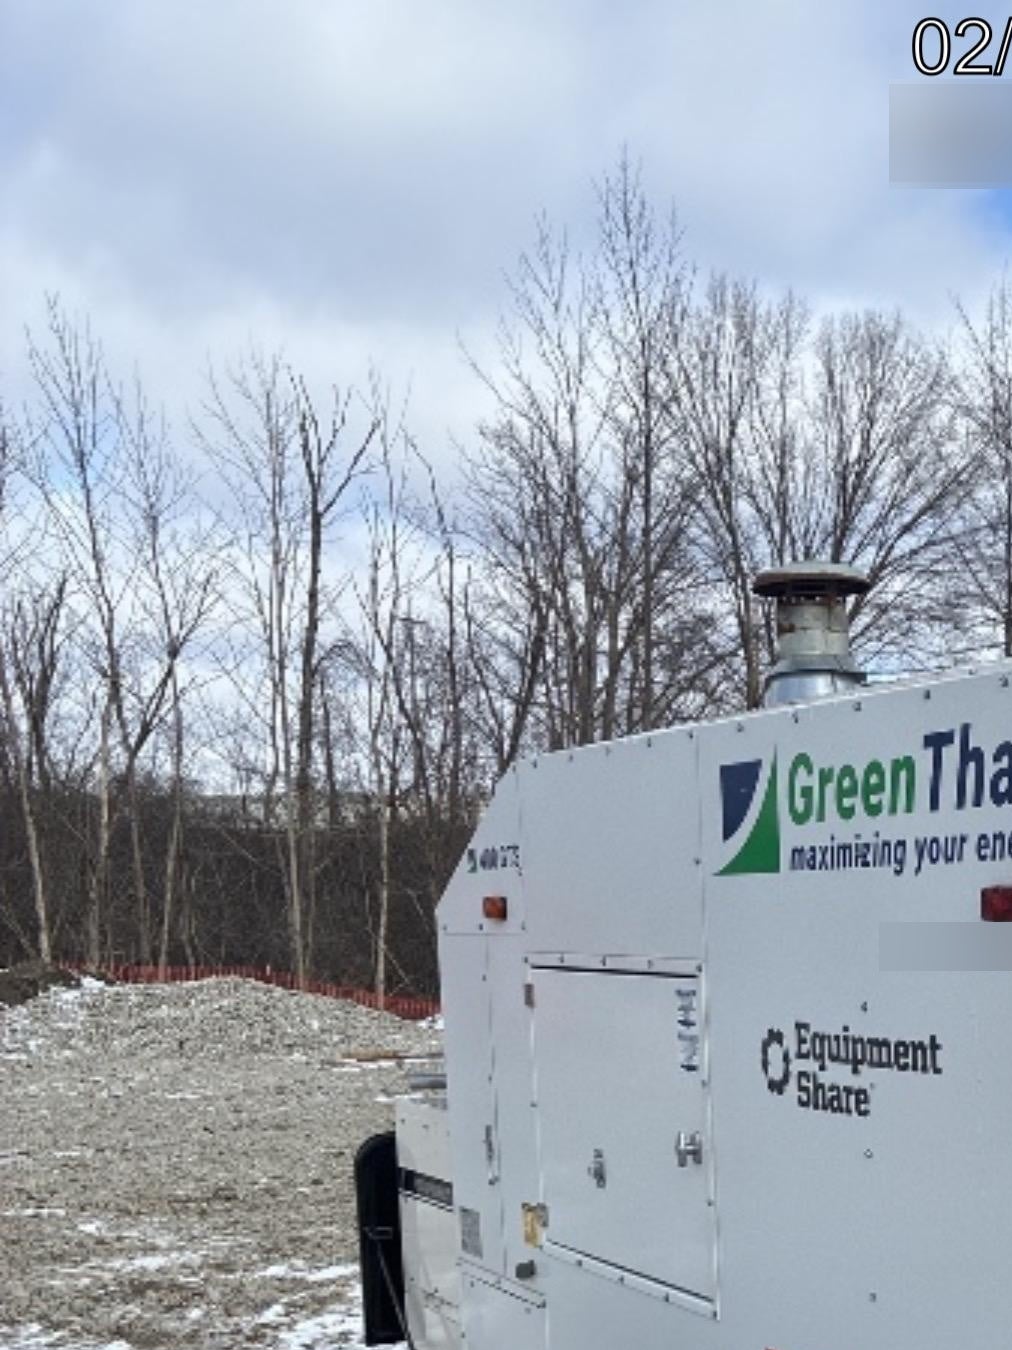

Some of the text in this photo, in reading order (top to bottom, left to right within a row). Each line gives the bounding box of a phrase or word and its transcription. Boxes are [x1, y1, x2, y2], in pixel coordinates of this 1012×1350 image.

[789, 830, 907, 877] maximizing
[914, 832, 968, 876] your
[794, 1021, 943, 1075] Equipment
[797, 1071, 871, 1117] Share
